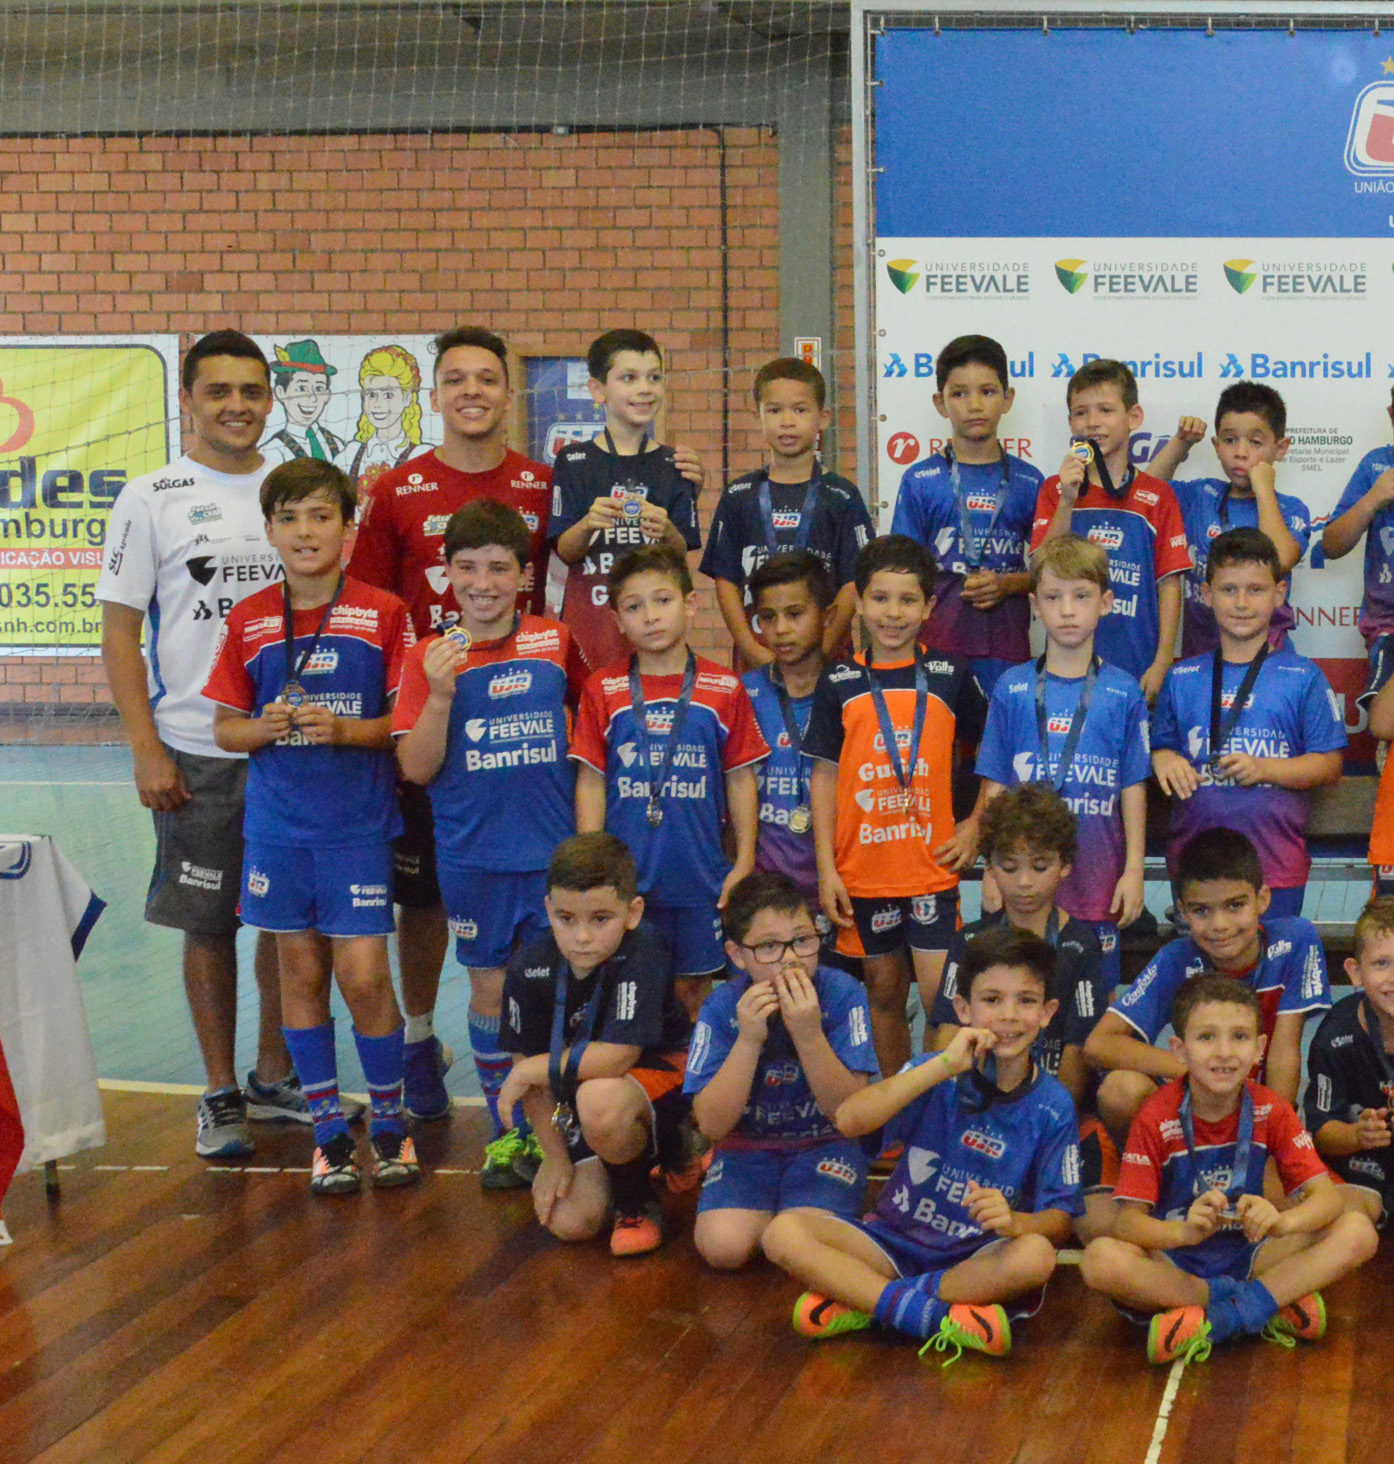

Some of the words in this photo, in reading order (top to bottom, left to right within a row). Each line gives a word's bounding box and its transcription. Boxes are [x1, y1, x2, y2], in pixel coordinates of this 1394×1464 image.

[925, 262, 1030, 272] UNIVERSIDADE
[1093, 262, 1198, 272] UNIVERSIDADE
[1261, 262, 1367, 272] UNIVERSIDADE
[925, 274, 1030, 293] FEEVALE
[1093, 274, 1198, 293] FEEVALE
[1261, 274, 1367, 293] FEEVALE
[1250, 351, 1372, 379] Banrisul
[1298, 435, 1353, 446] HAMBURGO
[395, 482, 439, 496] RENNER
[511, 479, 548, 490] RENNER
[221, 555, 279, 564] UNIVERSI
[331, 604, 378, 619] chipbyte
[0, 617, 102, 633] nh.com.br
[491, 675, 529, 694] UJR
[302, 692, 362, 701] NIVERSIDADE
[489, 710, 553, 725] UNIVERSIDADE
[489, 717, 554, 738] FEEVALE
[465, 740, 557, 772] Banrisul
[179, 874, 221, 890] Banrisul
